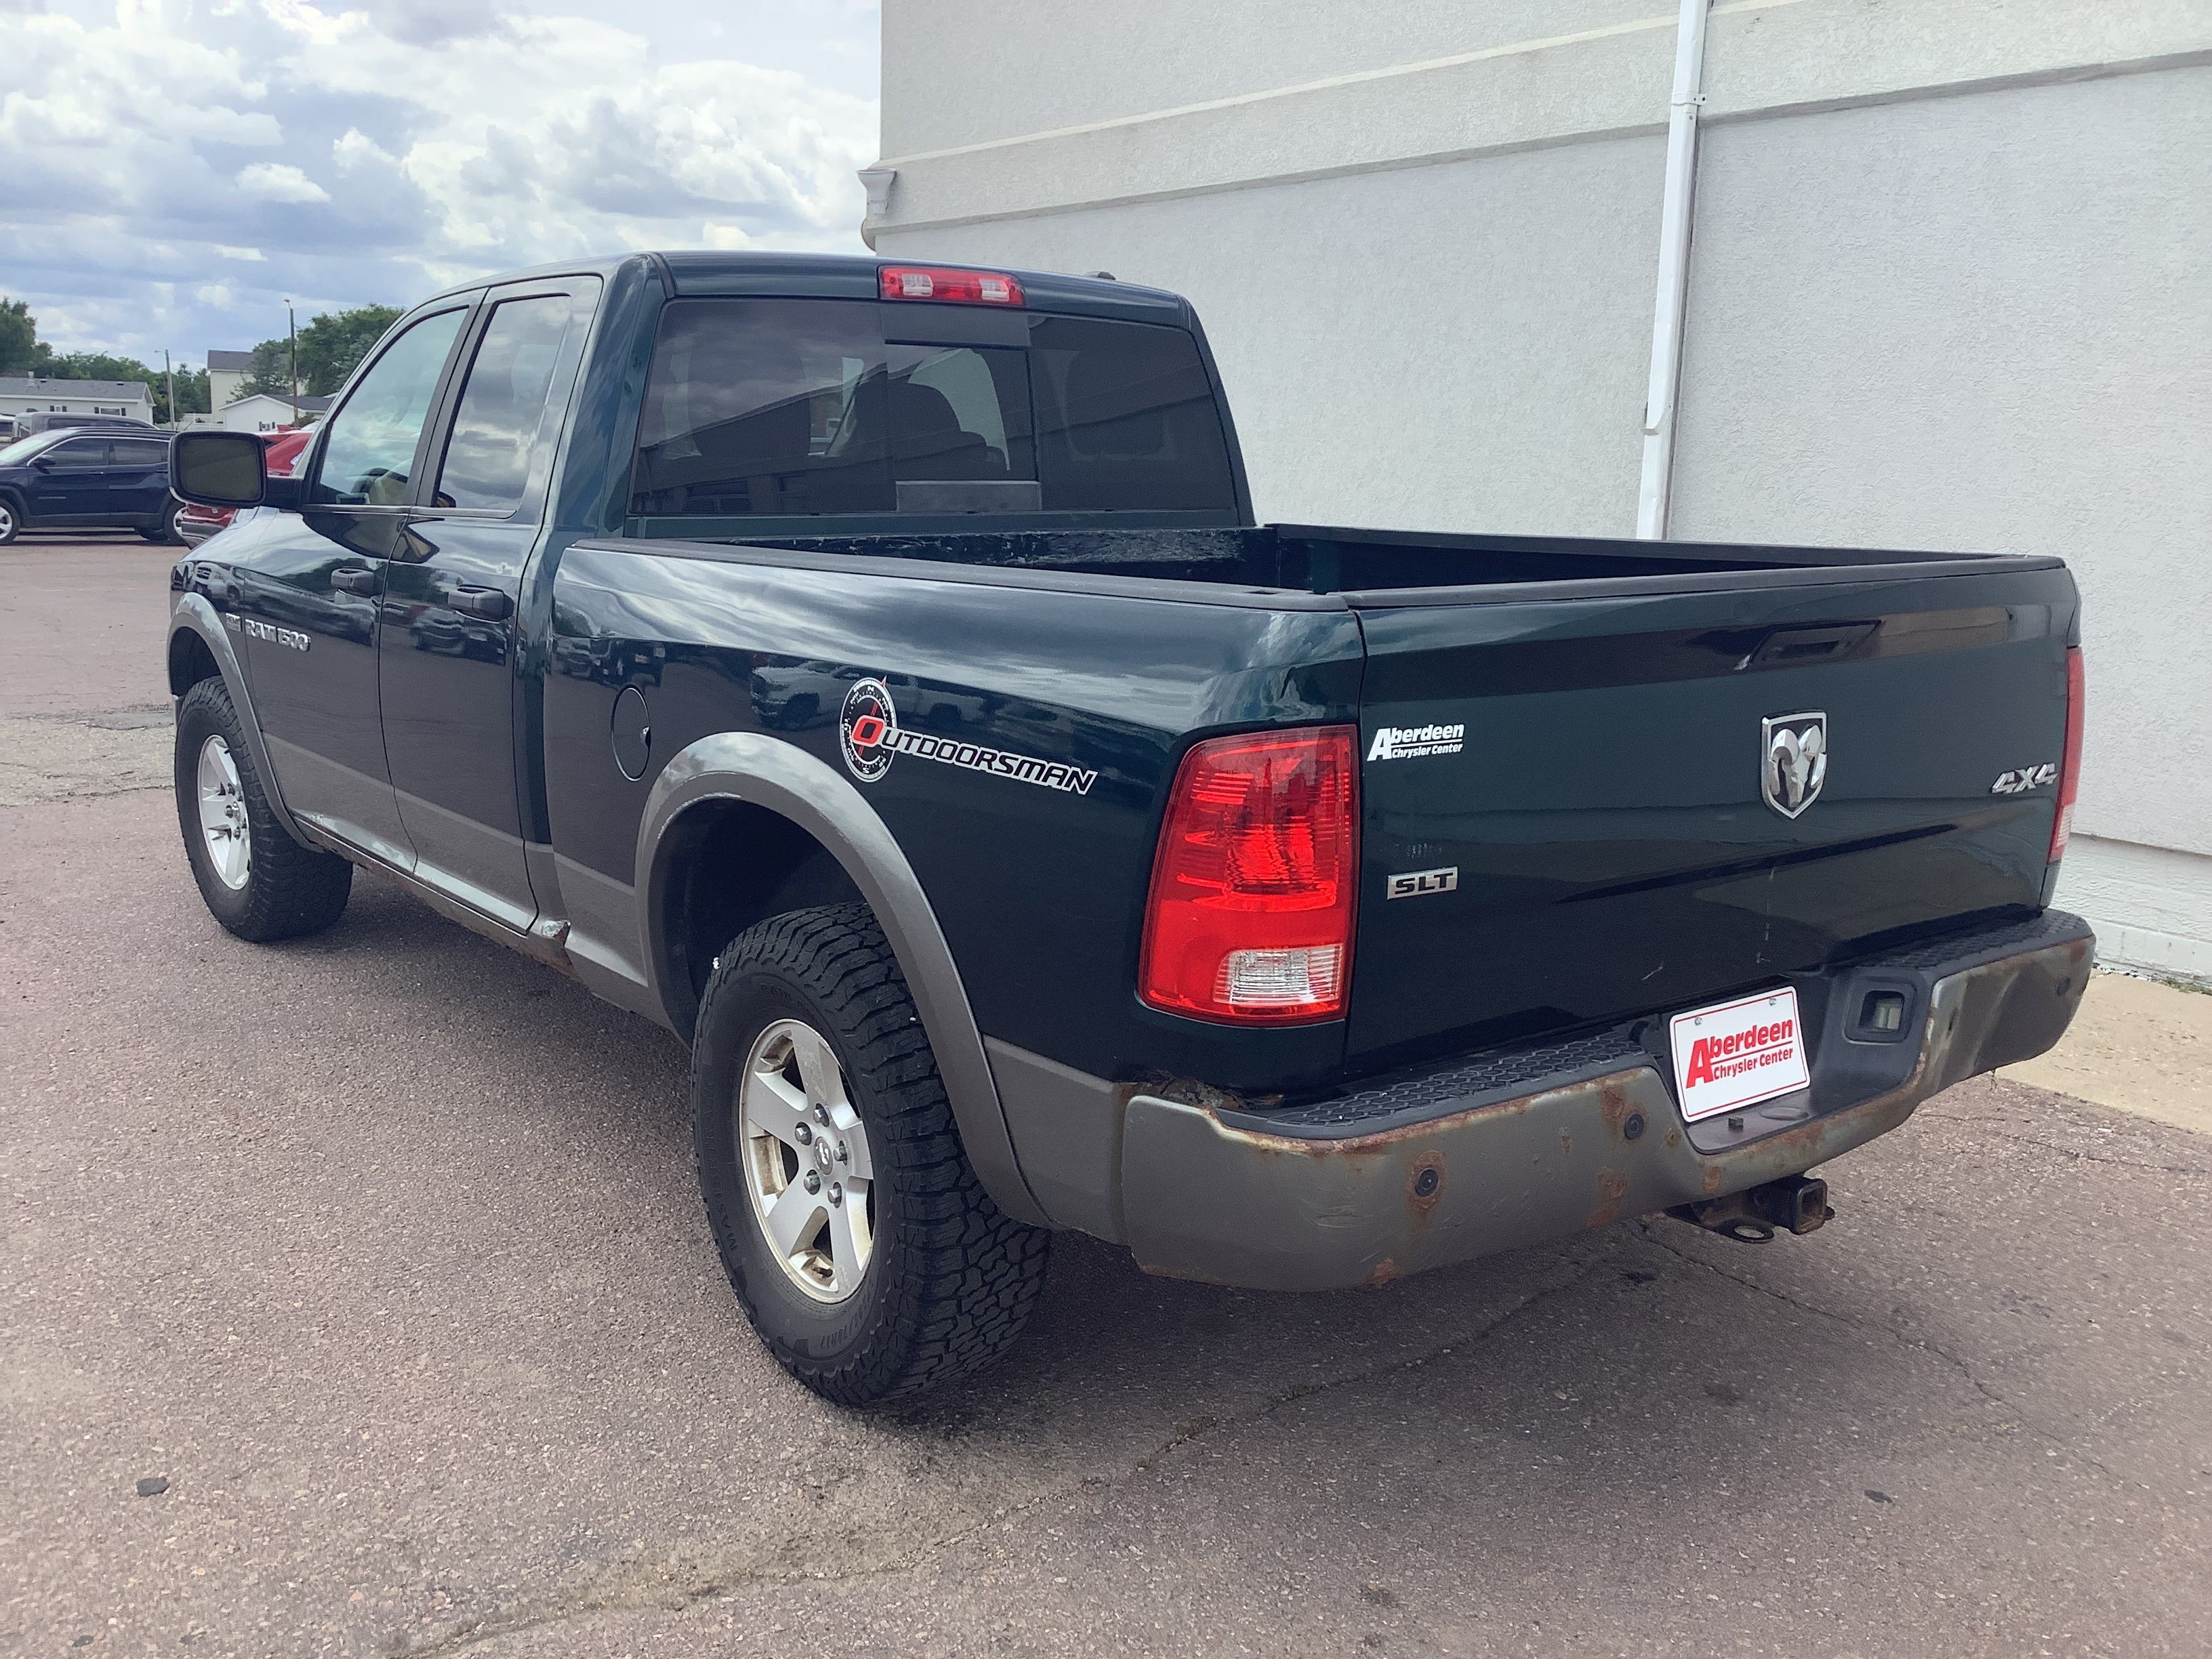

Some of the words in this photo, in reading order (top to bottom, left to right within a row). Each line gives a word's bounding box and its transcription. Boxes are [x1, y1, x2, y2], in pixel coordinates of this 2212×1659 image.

[853, 715, 1098, 795] OUTDOORSMAN
[1367, 724, 1465, 762] Aberdeen
[1391, 745, 1431, 759] Chrysler
[1432, 743, 1463, 755] Center
[1394, 872, 1454, 895] SLT
[1685, 1019, 1793, 1089] Aberdeen
[1714, 1057, 1758, 1080] Chrysler
[1759, 1047, 1793, 1067] Center
